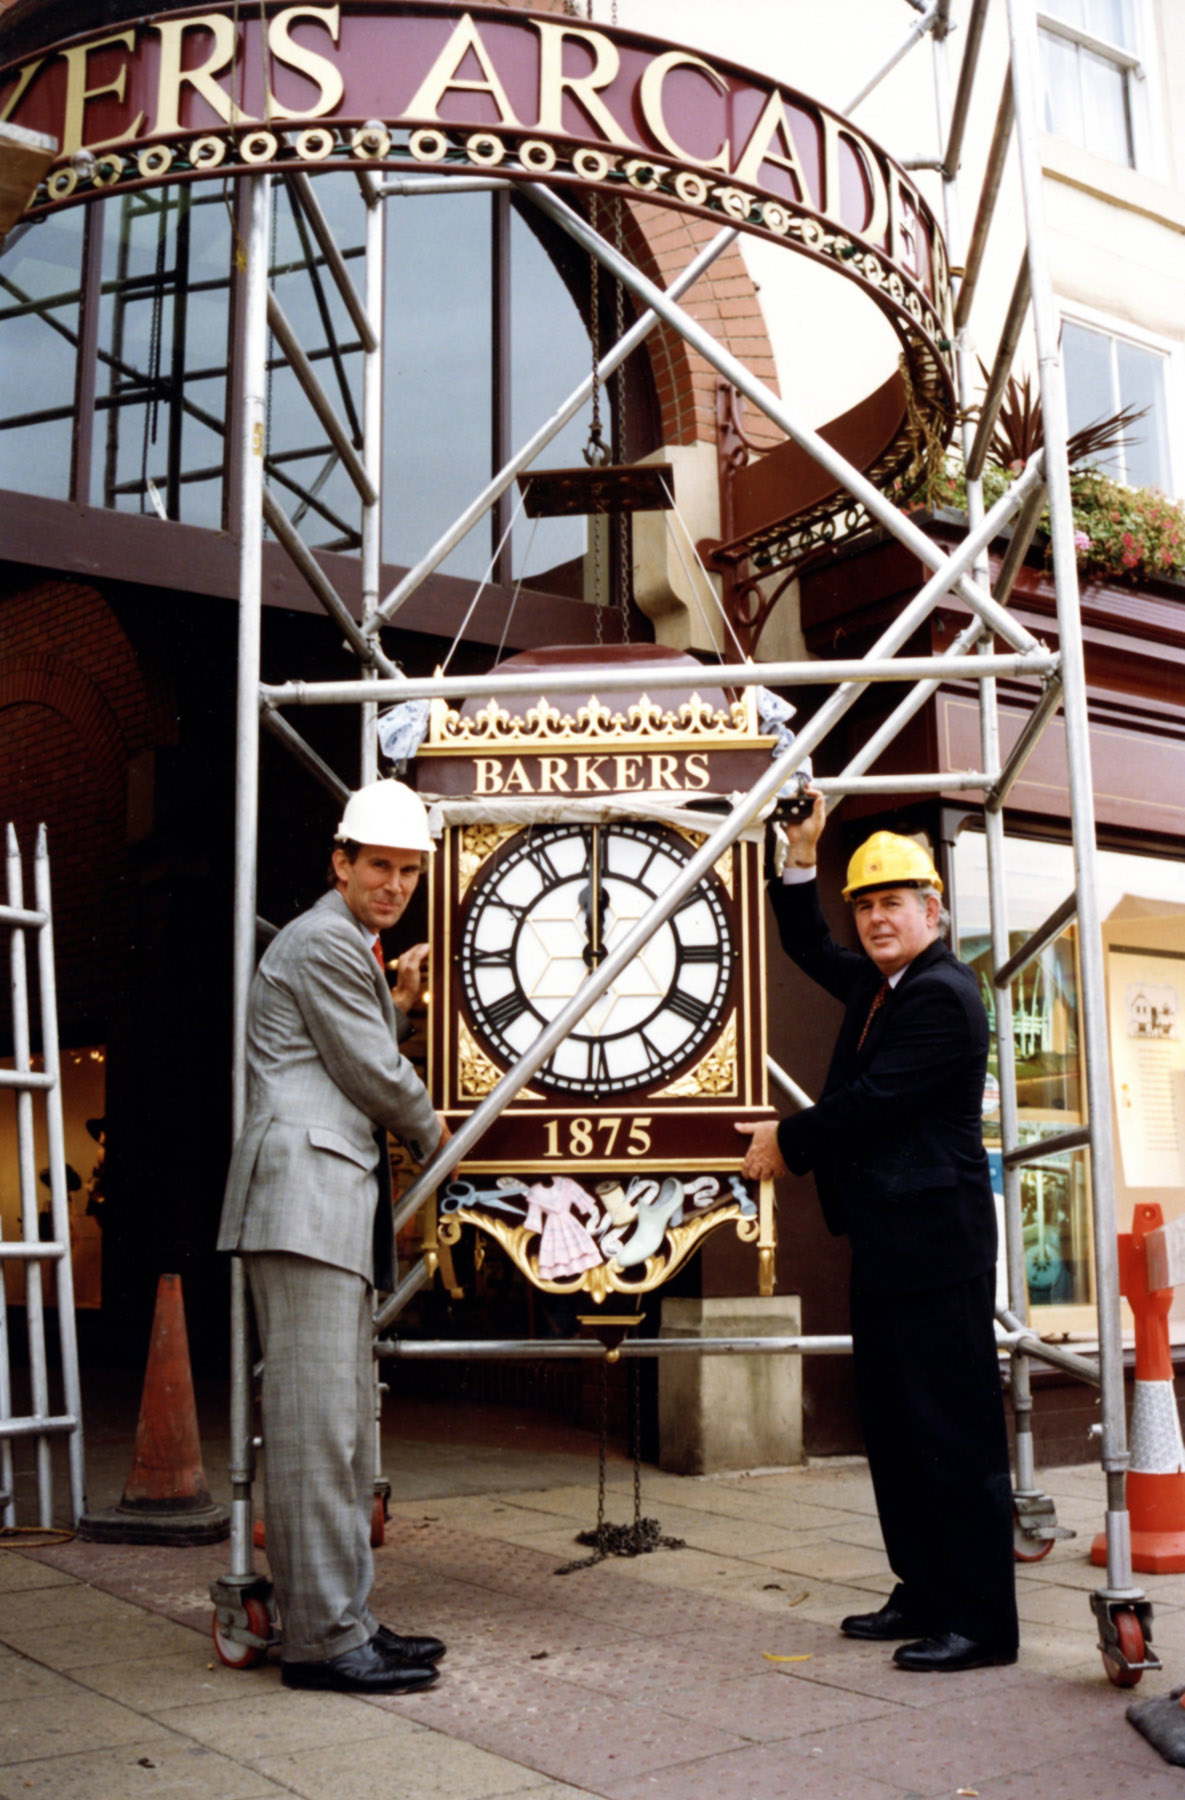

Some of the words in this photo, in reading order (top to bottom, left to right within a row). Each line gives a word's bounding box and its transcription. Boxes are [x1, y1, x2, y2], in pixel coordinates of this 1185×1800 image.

[402, 13, 924, 288] ARCADE
[473, 754, 710, 794] BARKERS
[543, 1117, 652, 1156] 1875
